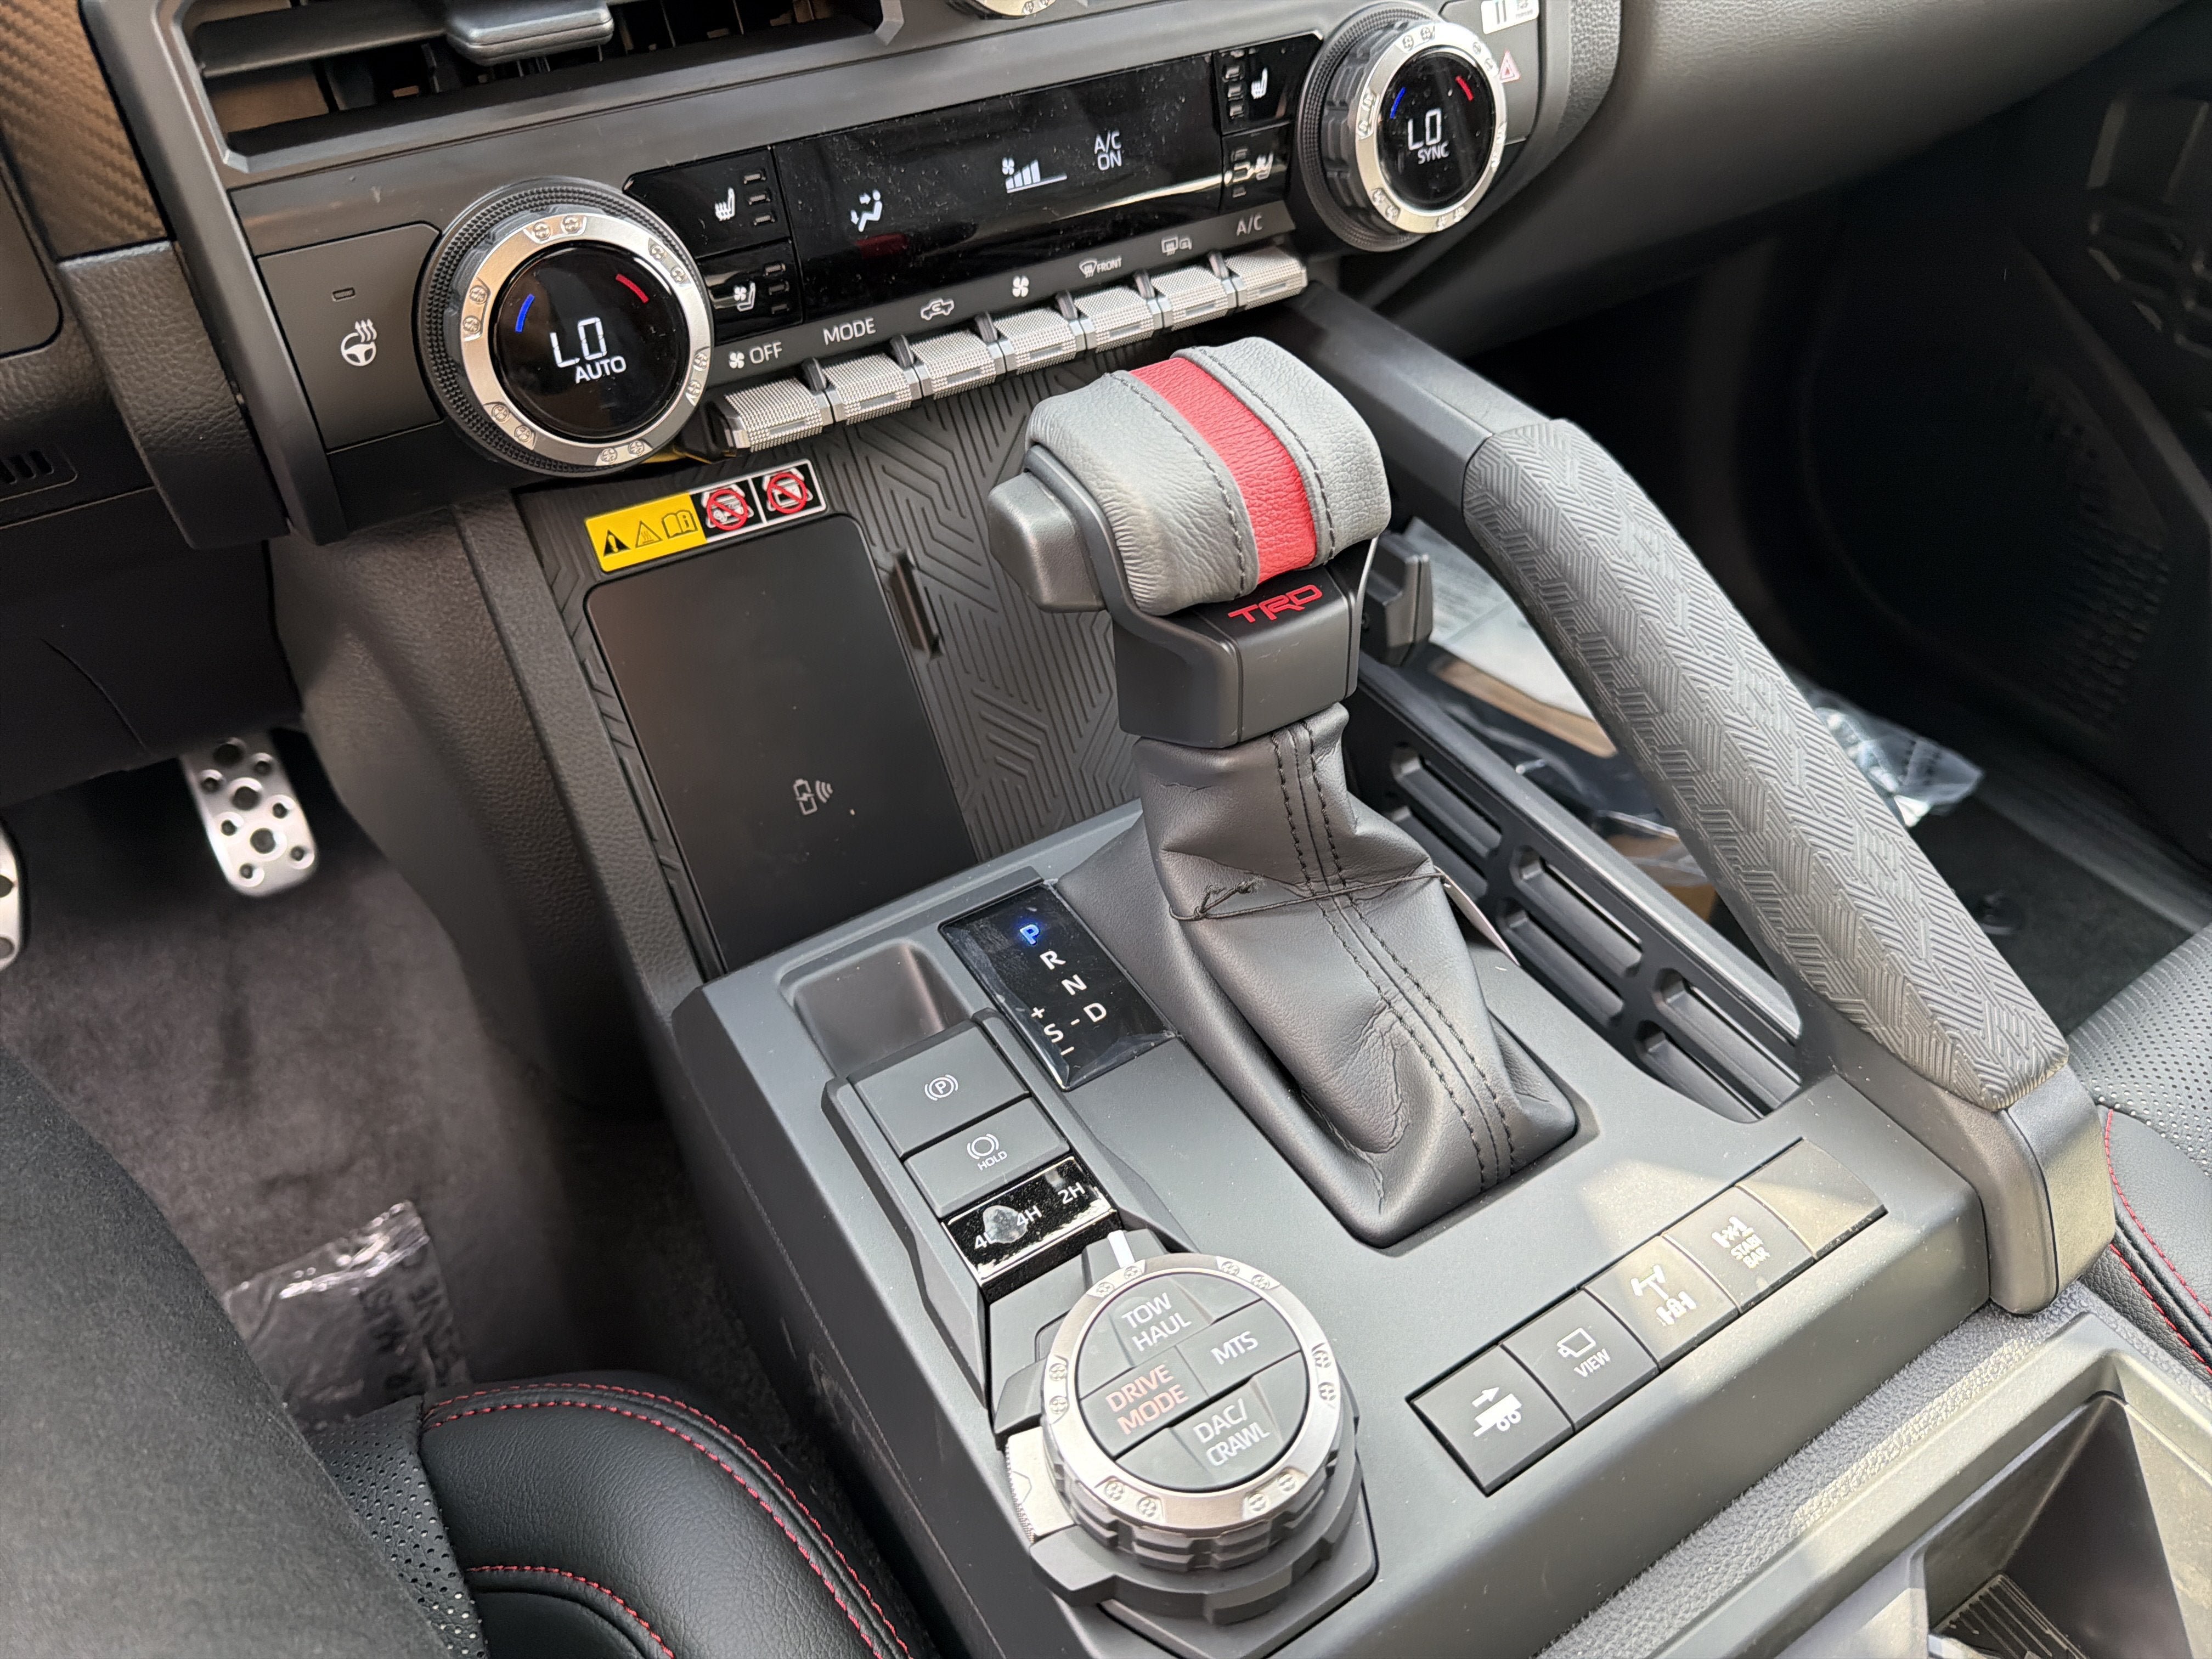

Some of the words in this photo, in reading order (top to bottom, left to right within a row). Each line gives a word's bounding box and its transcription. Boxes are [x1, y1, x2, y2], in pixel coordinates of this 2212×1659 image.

[1094, 131, 1122, 154] A/C
[1408, 109, 1442, 151] LO
[1097, 150, 1122, 171] ON
[1418, 142, 1450, 165] SYNC
[1236, 215, 1263, 236] A/C
[1097, 256, 1122, 273] FRONT
[550, 317, 607, 368] LO
[823, 317, 876, 346] MODE
[749, 342, 783, 364] OFF
[575, 356, 627, 384] AUTO
[1228, 584, 1323, 623] TRD
[1020, 924, 1040, 944] P
[1040, 950, 1066, 970] R
[1062, 974, 1087, 995] N
[1044, 1024, 1064, 1042] S
[1084, 1002, 1107, 1022] D
[977, 1152, 1008, 1171] HOLD
[974, 1232, 997, 1250] 4L
[1017, 1205, 1042, 1226] 4H
[1058, 1182, 1086, 1204] 2H
[1742, 1246, 1770, 1269] BAR
[1122, 1293, 1172, 1329] TOW
[1132, 1312, 1192, 1351] HAUL
[1211, 1331, 1259, 1365] MTS
[1573, 1348, 1611, 1378] VIEW
[1105, 1364, 1173, 1412] DRIVE
[1116, 1384, 1189, 1435] MODE
[1193, 1398, 1246, 1443] DAC/
[1206, 1422, 1271, 1467] CRAWL
